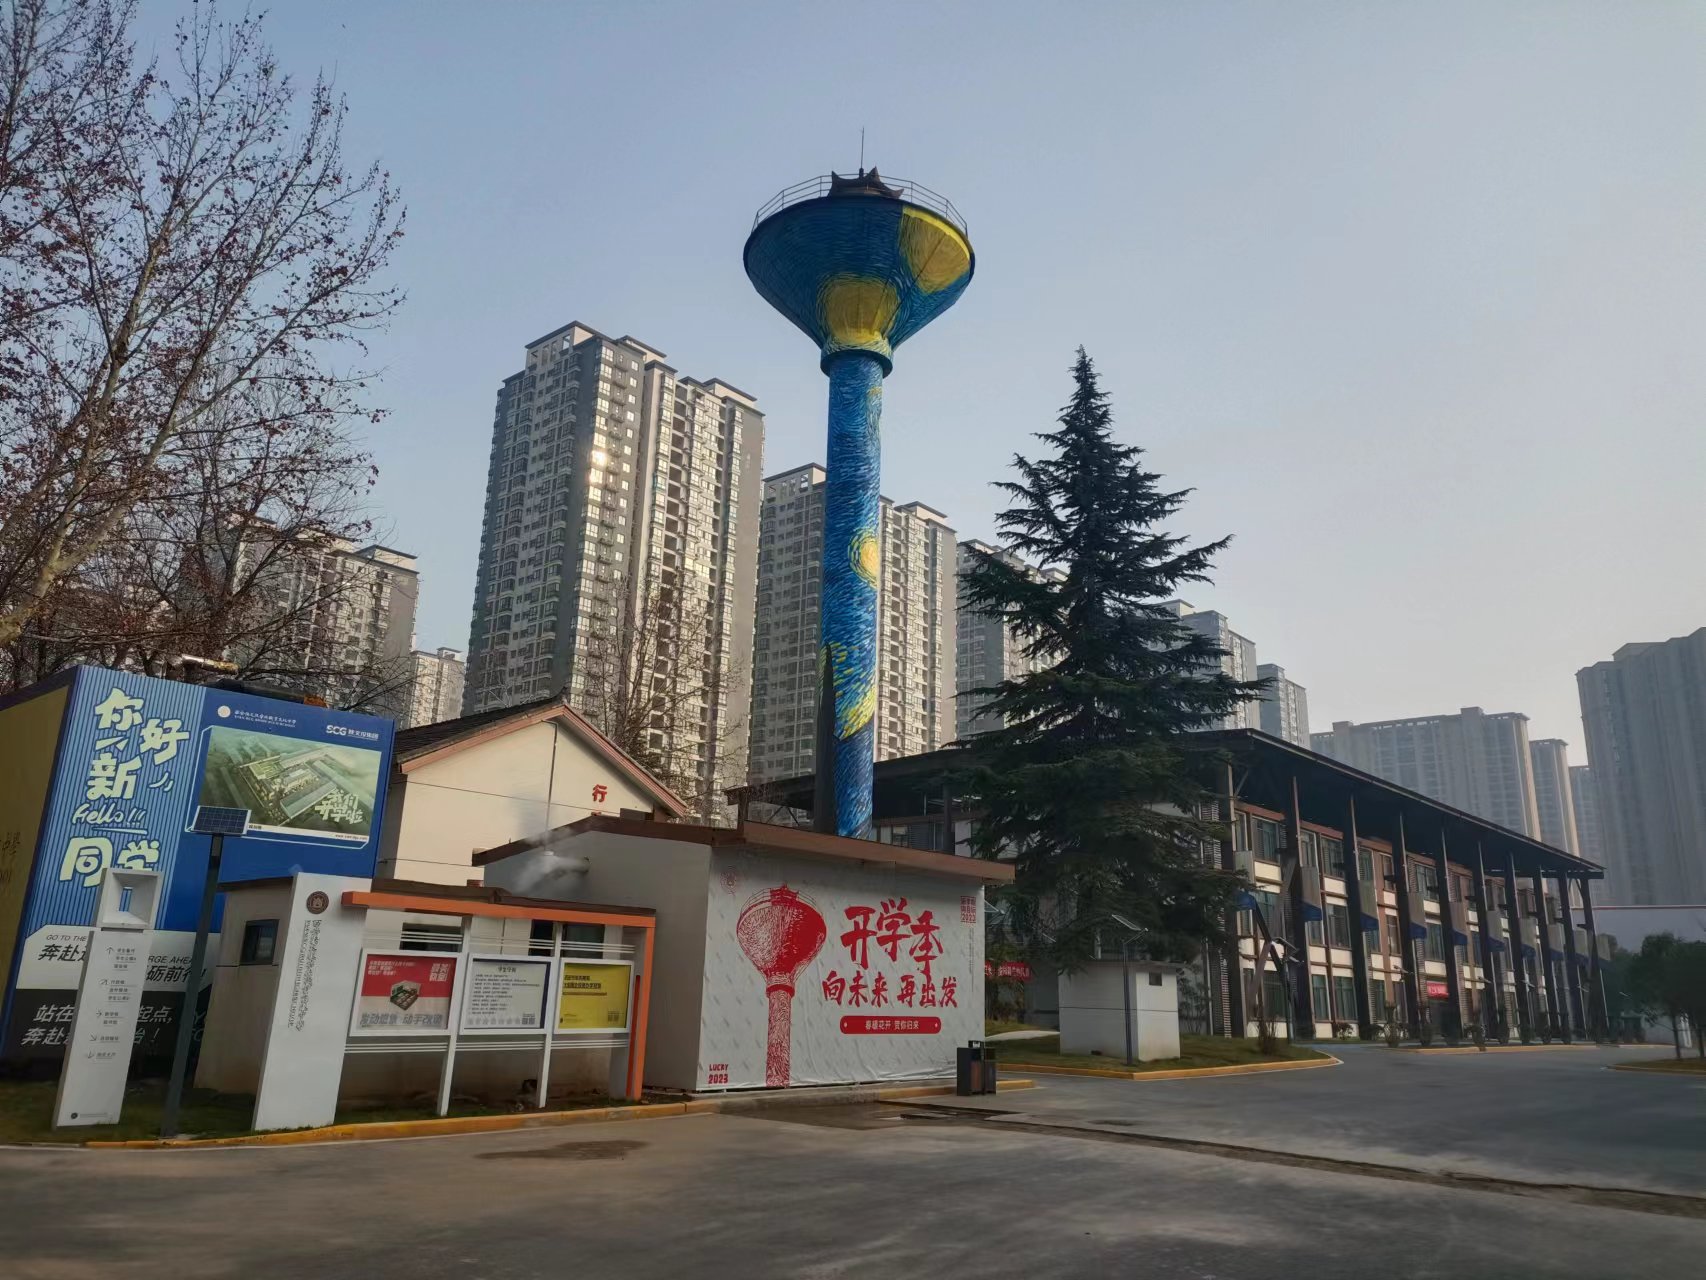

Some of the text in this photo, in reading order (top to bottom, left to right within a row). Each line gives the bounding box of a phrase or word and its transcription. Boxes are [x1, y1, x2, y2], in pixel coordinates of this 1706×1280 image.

[326, 724, 347, 736] SCG
[86, 752, 143, 800] 新
[840, 897, 944, 976] 开学季
[822, 970, 958, 1008] 向未来 再出发
[21, 1027, 69, 1045] 奔赴
[709, 1063, 729, 1072] LUCKY
[708, 1073, 729, 1084] 2023
